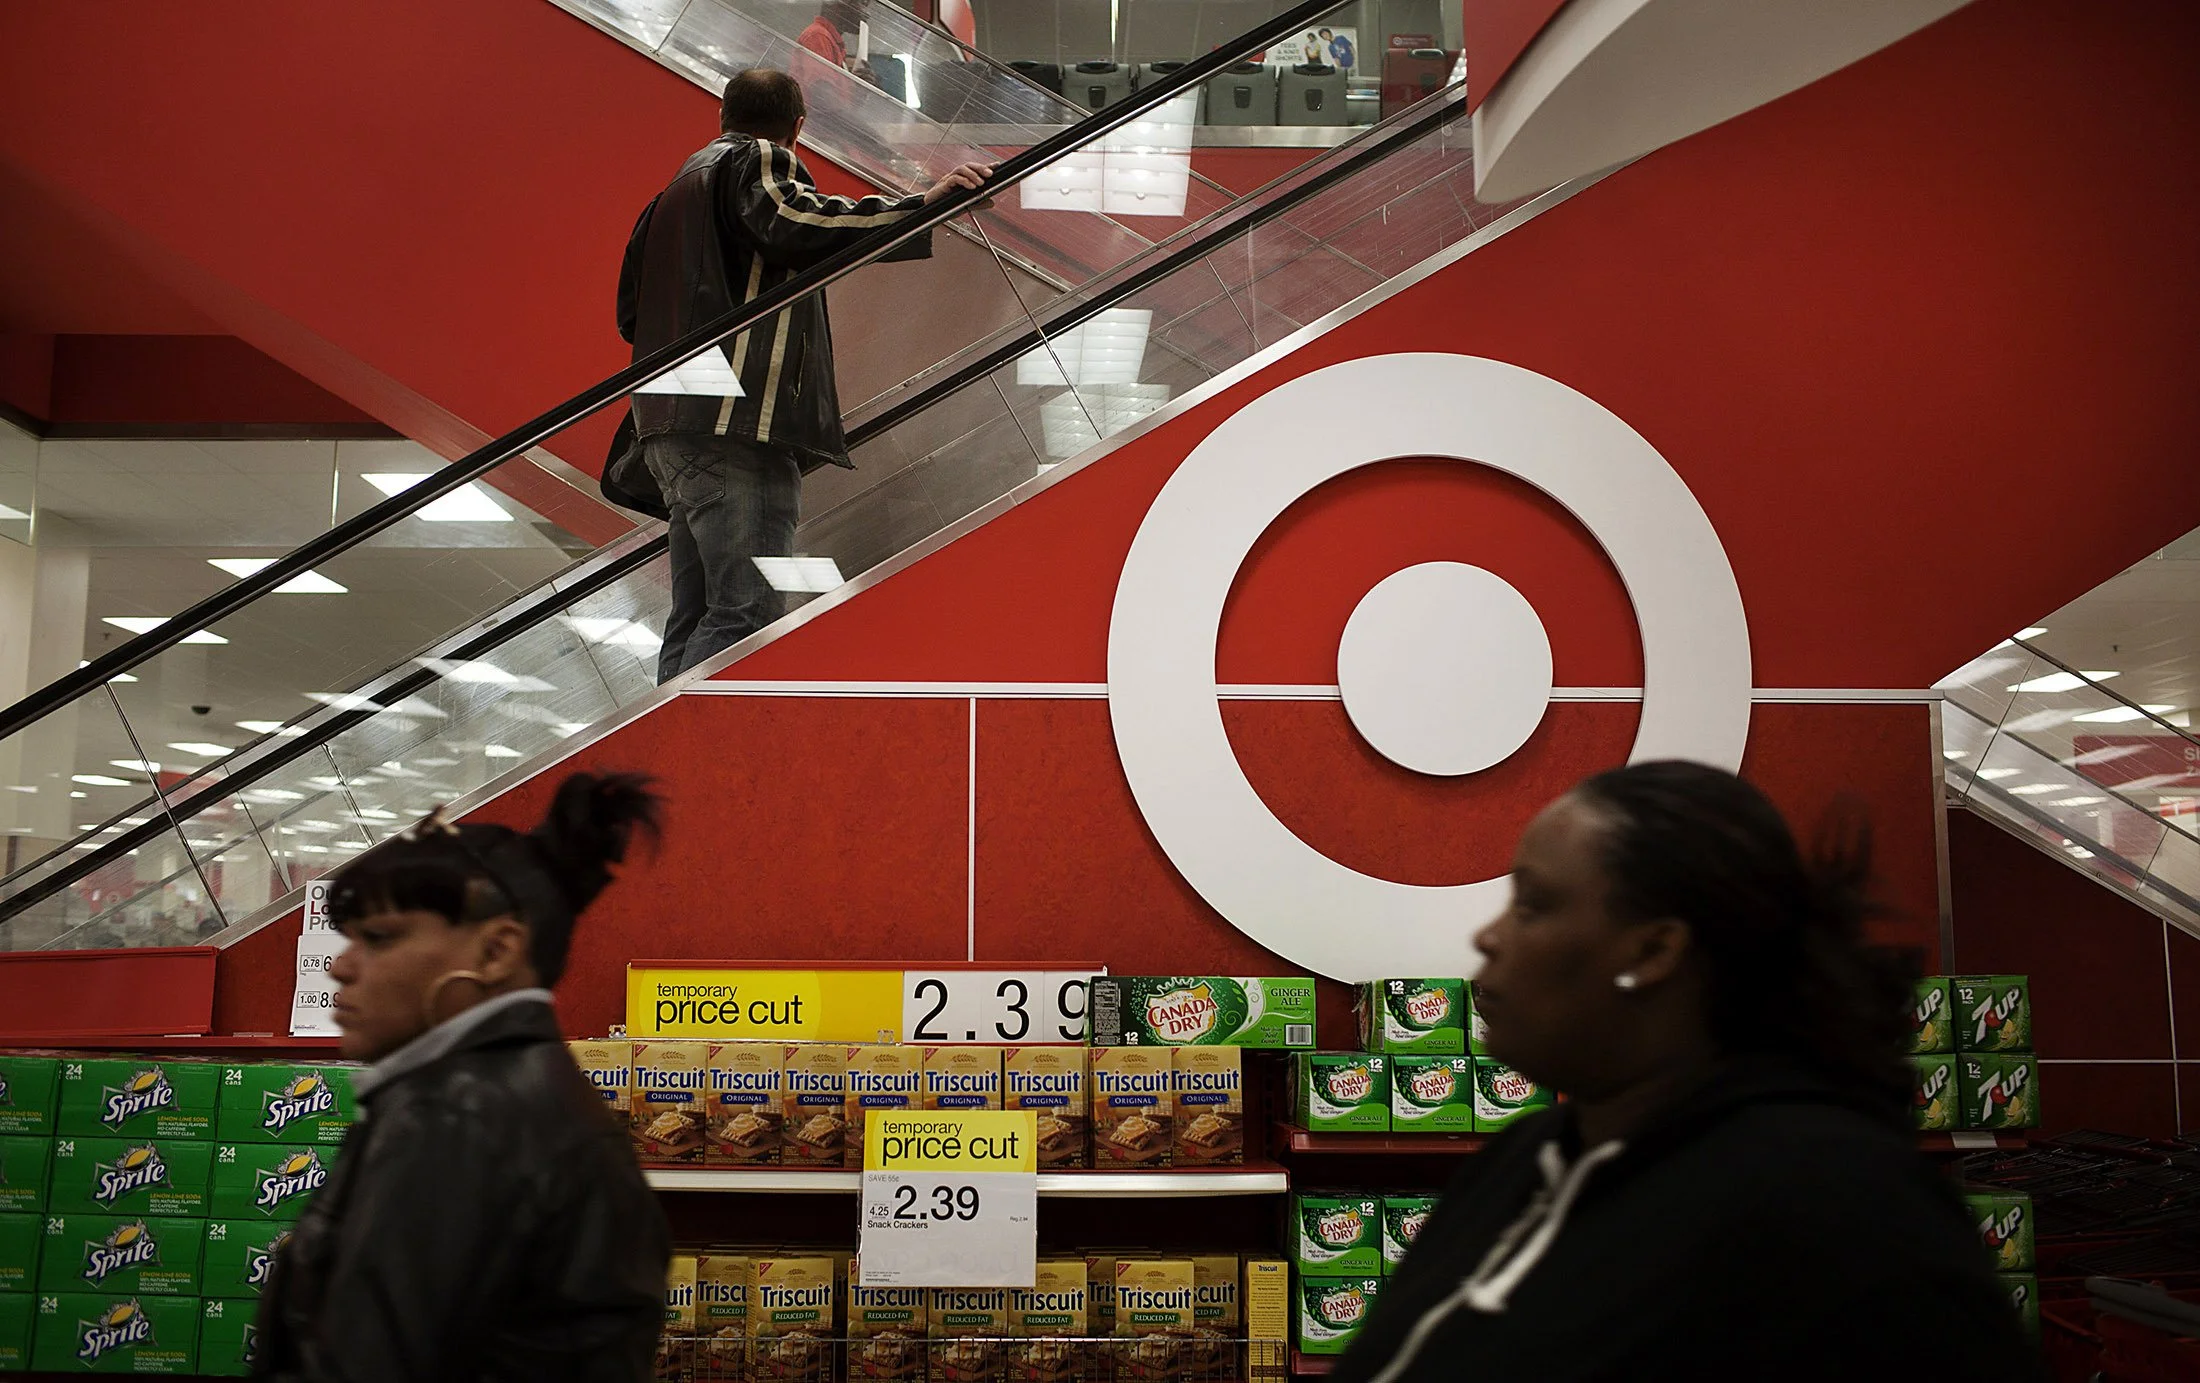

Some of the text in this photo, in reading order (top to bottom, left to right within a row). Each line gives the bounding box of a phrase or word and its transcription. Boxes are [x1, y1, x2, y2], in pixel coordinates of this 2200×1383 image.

[303, 958, 320, 968] 0.78
[657, 983, 738, 1001] temporary
[1389, 980, 1404, 991] 12
[1270, 988, 1311, 997] GINGER
[1959, 988, 1973, 1001] 12
[300, 995, 317, 1004] 1.00
[1281, 997, 1301, 1005] ALE
[1408, 995, 1450, 1016] CANADA
[1916, 987, 1942, 1023] UP
[656, 995, 803, 1031] price cut
[1148, 998, 1218, 1028] CANADA
[1420, 1007, 1442, 1020] DRY
[1971, 988, 2020, 1045] 7UP
[1169, 1014, 1202, 1034] DRY
[1124, 1031, 1139, 1042] 12
[65, 1064, 82, 1075] 24
[1368, 1058, 1383, 1069] 12
[1451, 1059, 1466, 1070] 12
[1967, 1062, 1981, 1075] 12
[225, 1069, 242, 1080] 24
[584, 1065, 629, 1087] scuit
[635, 1066, 705, 1089] Triscuit
[709, 1068, 780, 1090] Triscuit
[786, 1069, 846, 1091] Triscu
[847, 1070, 920, 1092] Triscuit
[926, 1070, 998, 1092] Triscuit
[1008, 1070, 1080, 1092] Triscuit
[1096, 1070, 1168, 1092] Triscuit
[1172, 1068, 1239, 1090] Triscuit
[1330, 1074, 1371, 1093] CANADA
[1413, 1075, 1455, 1093] CANADA
[1494, 1076, 1531, 1093] CANAD
[1922, 1064, 1948, 1100] UP
[651, 1092, 688, 1101] ORIGINAL
[1342, 1085, 1363, 1097] DRY
[1425, 1085, 1446, 1098] DRY
[1507, 1086, 1528, 1098] DRY
[1977, 1064, 2028, 1122] 7UP
[103, 1084, 173, 1124] Sprite
[726, 1094, 763, 1102] ORIGINAL
[802, 1095, 840, 1103] ORIGINAL
[865, 1096, 903, 1104] ORIGINAL
[943, 1097, 981, 1105] ORIGINAL
[1025, 1097, 1063, 1105] ORIGINAL
[1114, 1097, 1152, 1105] ORIGINAL
[1186, 1095, 1223, 1103] ORIGINAL
[264, 1089, 333, 1129] Sprite
[883, 1120, 963, 1137] temporary
[57, 1141, 74, 1152] 24
[218, 1146, 236, 1157] 24
[882, 1132, 1019, 1167] price cut
[95, 1162, 165, 1201] Sprite
[257, 1167, 327, 1207] Sprite
[893, 1185, 980, 1221] 2.39
[1360, 1202, 1374, 1212] 12
[869, 1206, 890, 1216] 4.25
[47, 1218, 64, 1229] 24
[209, 1223, 227, 1235] 24
[867, 1221, 928, 1229] Snack Crackers
[1320, 1218, 1362, 1236] CANADA
[1403, 1222, 1424, 1236] CAN
[1333, 1229, 1354, 1241] DRY
[85, 1239, 155, 1278] Sprite
[698, 1280, 746, 1302] Trisc
[1362, 1280, 1377, 1291] 12
[41, 1297, 58, 1308] 24
[760, 1284, 830, 1308] Triscuit
[851, 1286, 924, 1307] Triscuit
[931, 1287, 1004, 1310] Triscuit
[1011, 1288, 1084, 1310] Triscuit
[1118, 1287, 1191, 1309] Triscuit
[206, 1301, 224, 1313] 24
[1322, 1296, 1365, 1314] CANADA
[867, 1312, 909, 1320] REDUCED FAT
[1027, 1316, 1057, 1324] REDUCED
[1134, 1314, 1163, 1322] REDUCED
[1335, 1307, 1356, 1320] DRY
[79, 1317, 149, 1357] Sprite
